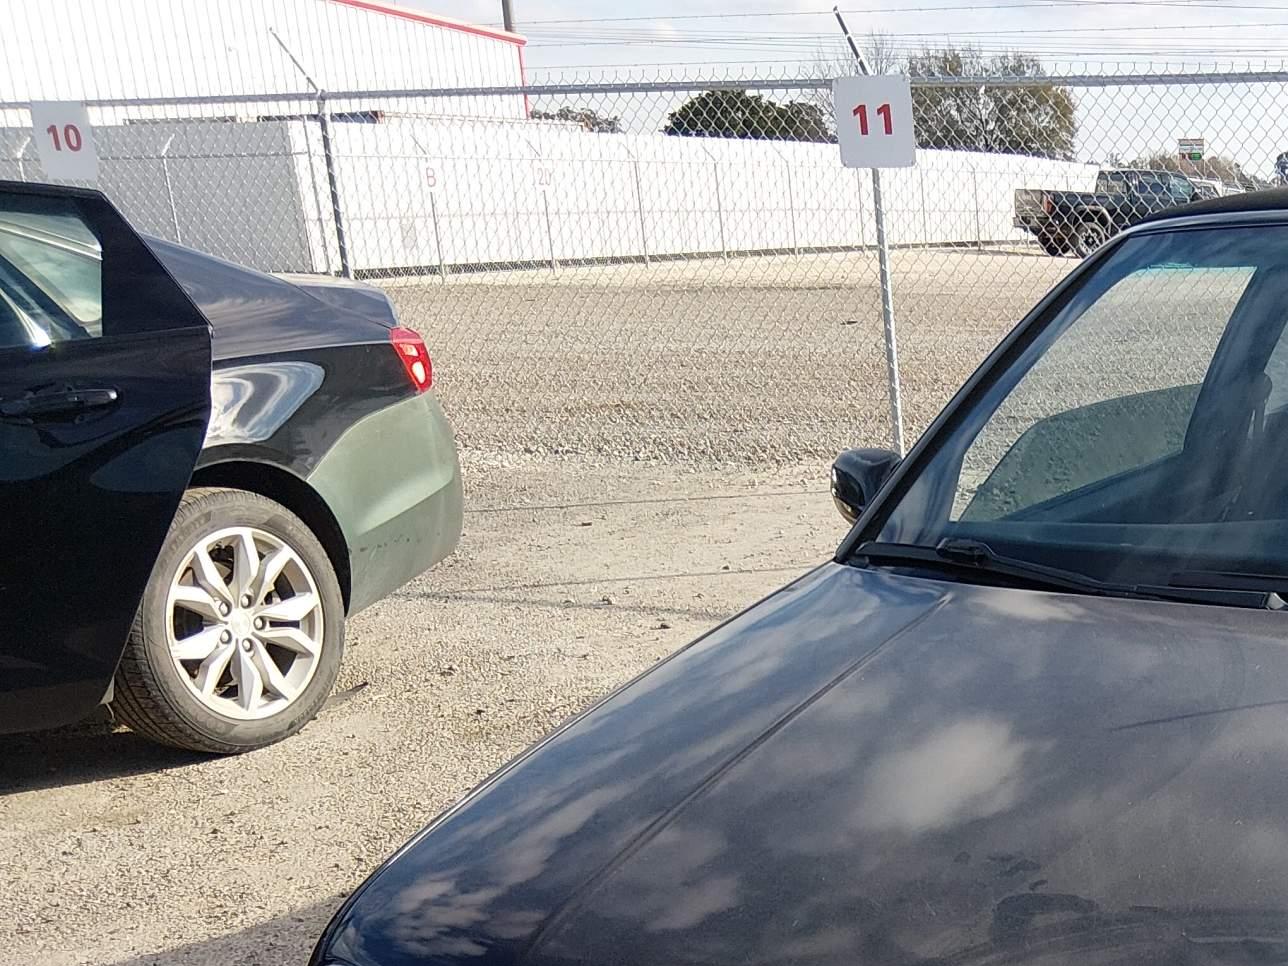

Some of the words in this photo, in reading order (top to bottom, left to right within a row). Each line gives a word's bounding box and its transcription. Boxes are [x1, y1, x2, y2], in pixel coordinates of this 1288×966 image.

[852, 103, 893, 136] 11
[46, 124, 82, 152] 10
[425, 167, 437, 188] B
